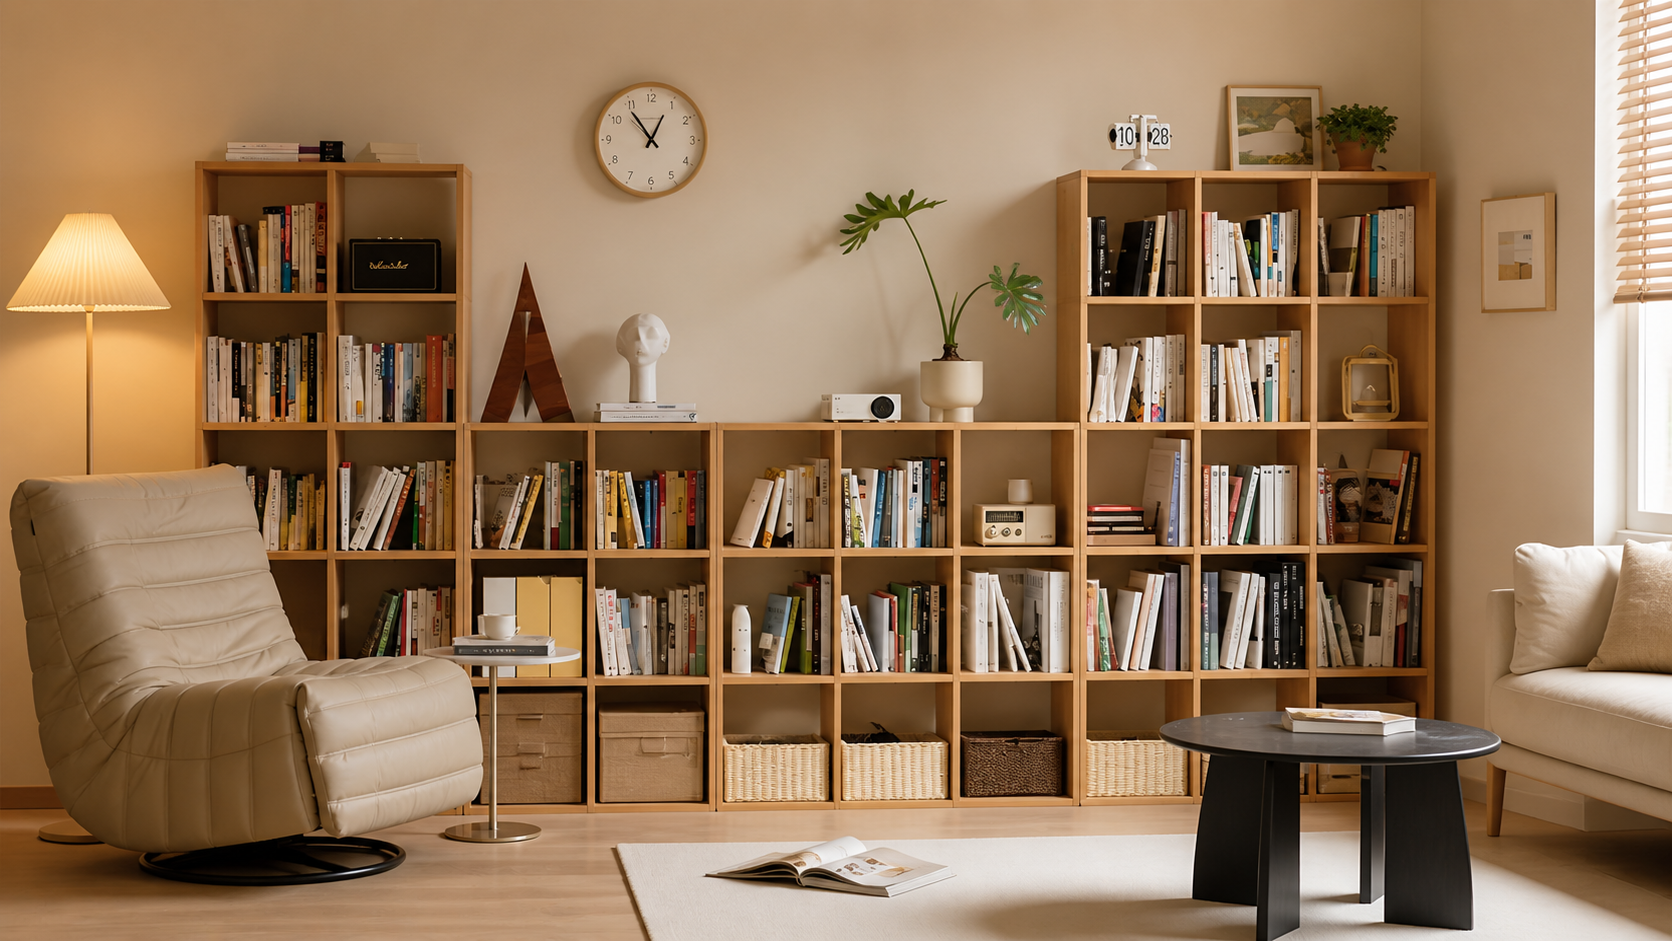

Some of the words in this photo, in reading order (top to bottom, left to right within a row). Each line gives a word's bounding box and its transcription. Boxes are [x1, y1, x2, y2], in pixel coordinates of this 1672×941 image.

[646, 93, 657, 103] 12
[628, 100, 635, 110] 11
[611, 115, 622, 125] 10
[682, 115, 689, 125] 2
[605, 134, 612, 145] 9
[689, 135, 696, 146] 3
[1118, 126, 1134, 146] 10
[1152, 127, 1169, 145] 28
[611, 154, 619, 164] 8
[682, 156, 689, 166] 4
[627, 170, 634, 180] 7
[668, 170, 675, 180] 5
[647, 176, 655, 186] 6
